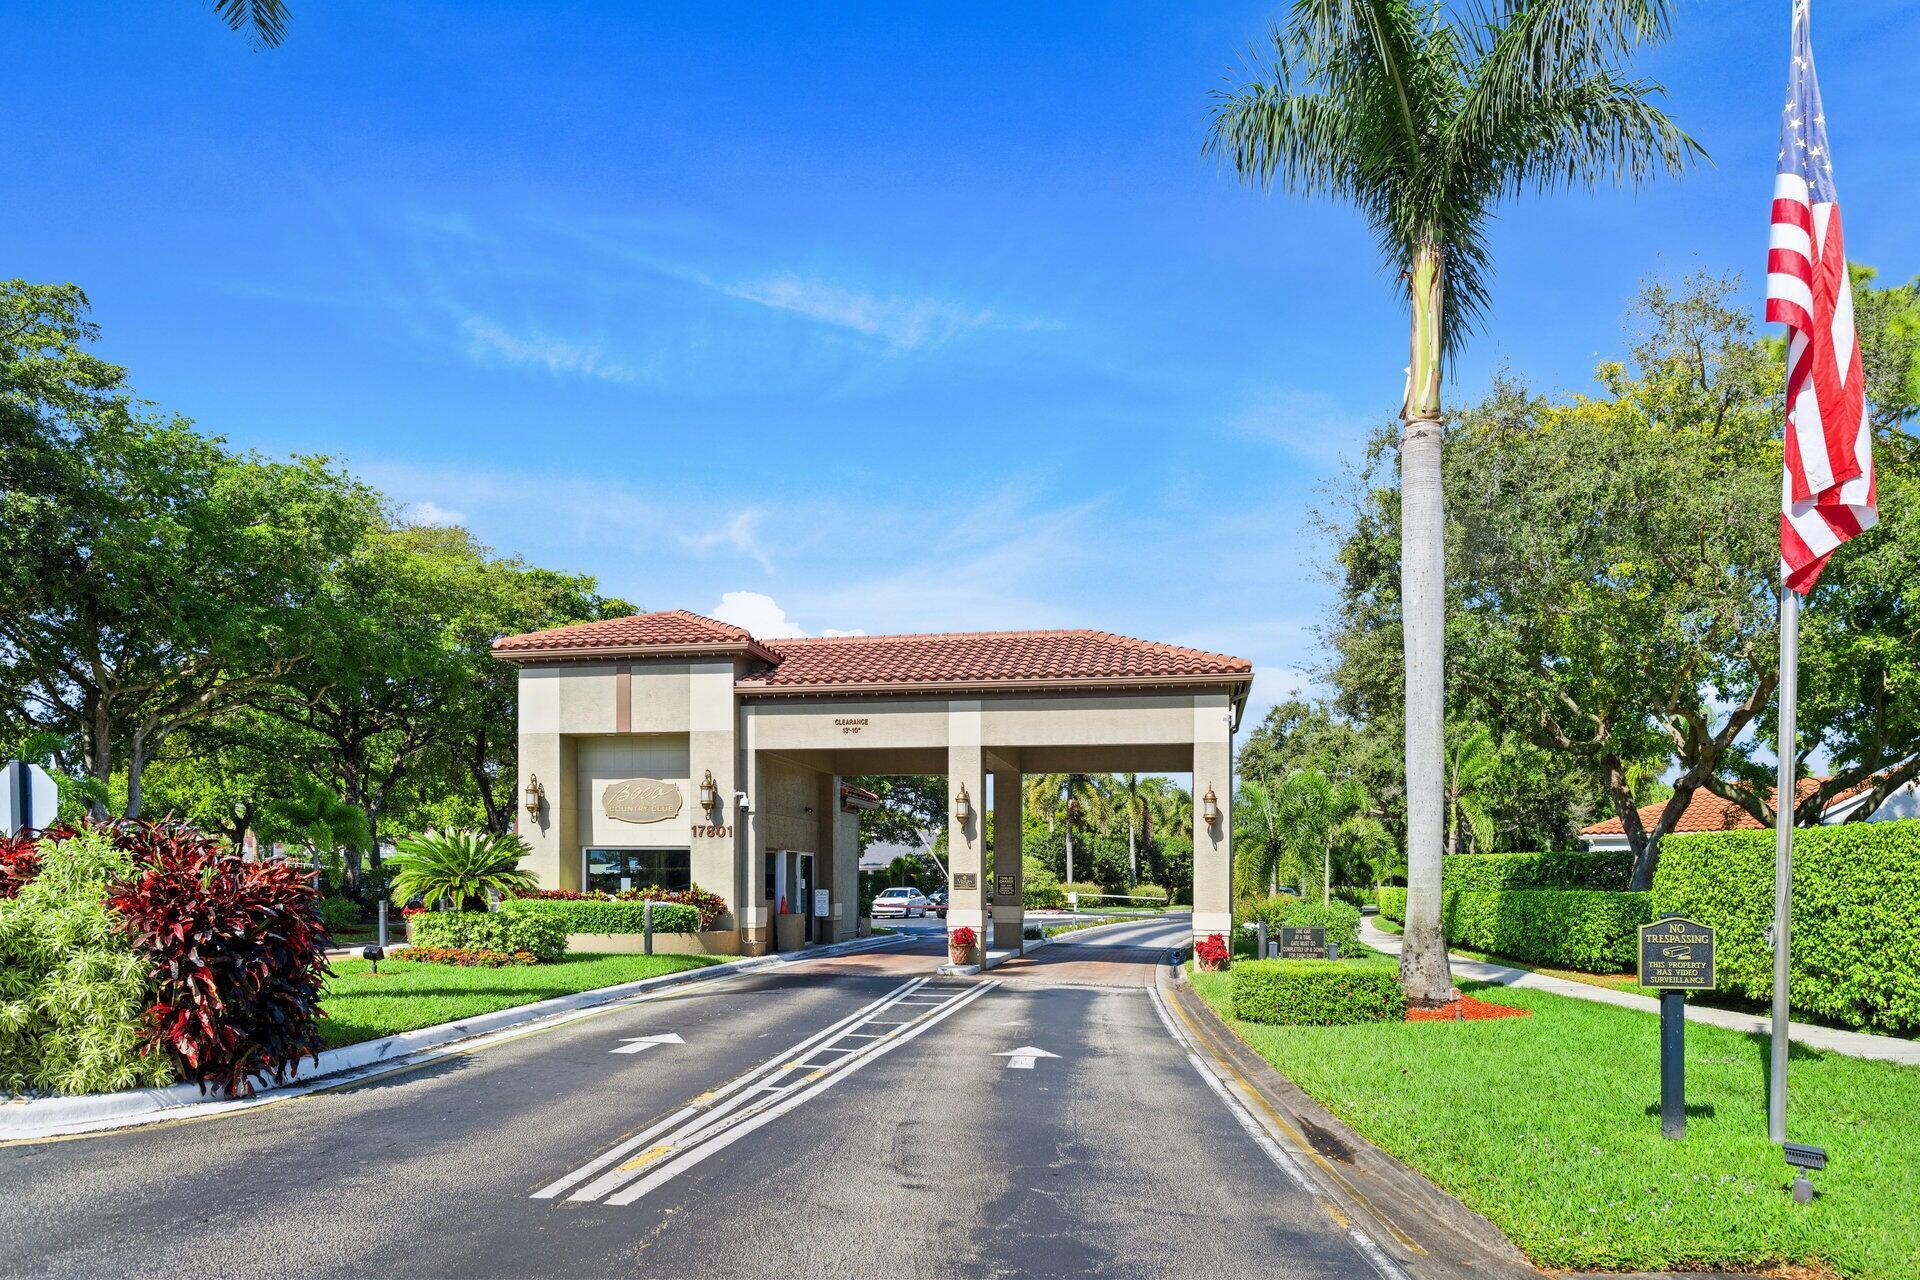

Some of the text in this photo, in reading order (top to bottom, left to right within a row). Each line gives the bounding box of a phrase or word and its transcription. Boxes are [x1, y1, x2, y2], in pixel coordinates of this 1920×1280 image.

[691, 825, 733, 838] 17801
[1669, 923, 1685, 934] NO
[1646, 934, 1709, 944] TRESPASSING
[1648, 961, 1707, 969] THIS PROPERTY
[1650, 976, 1705, 984] SURVEILLANCE
